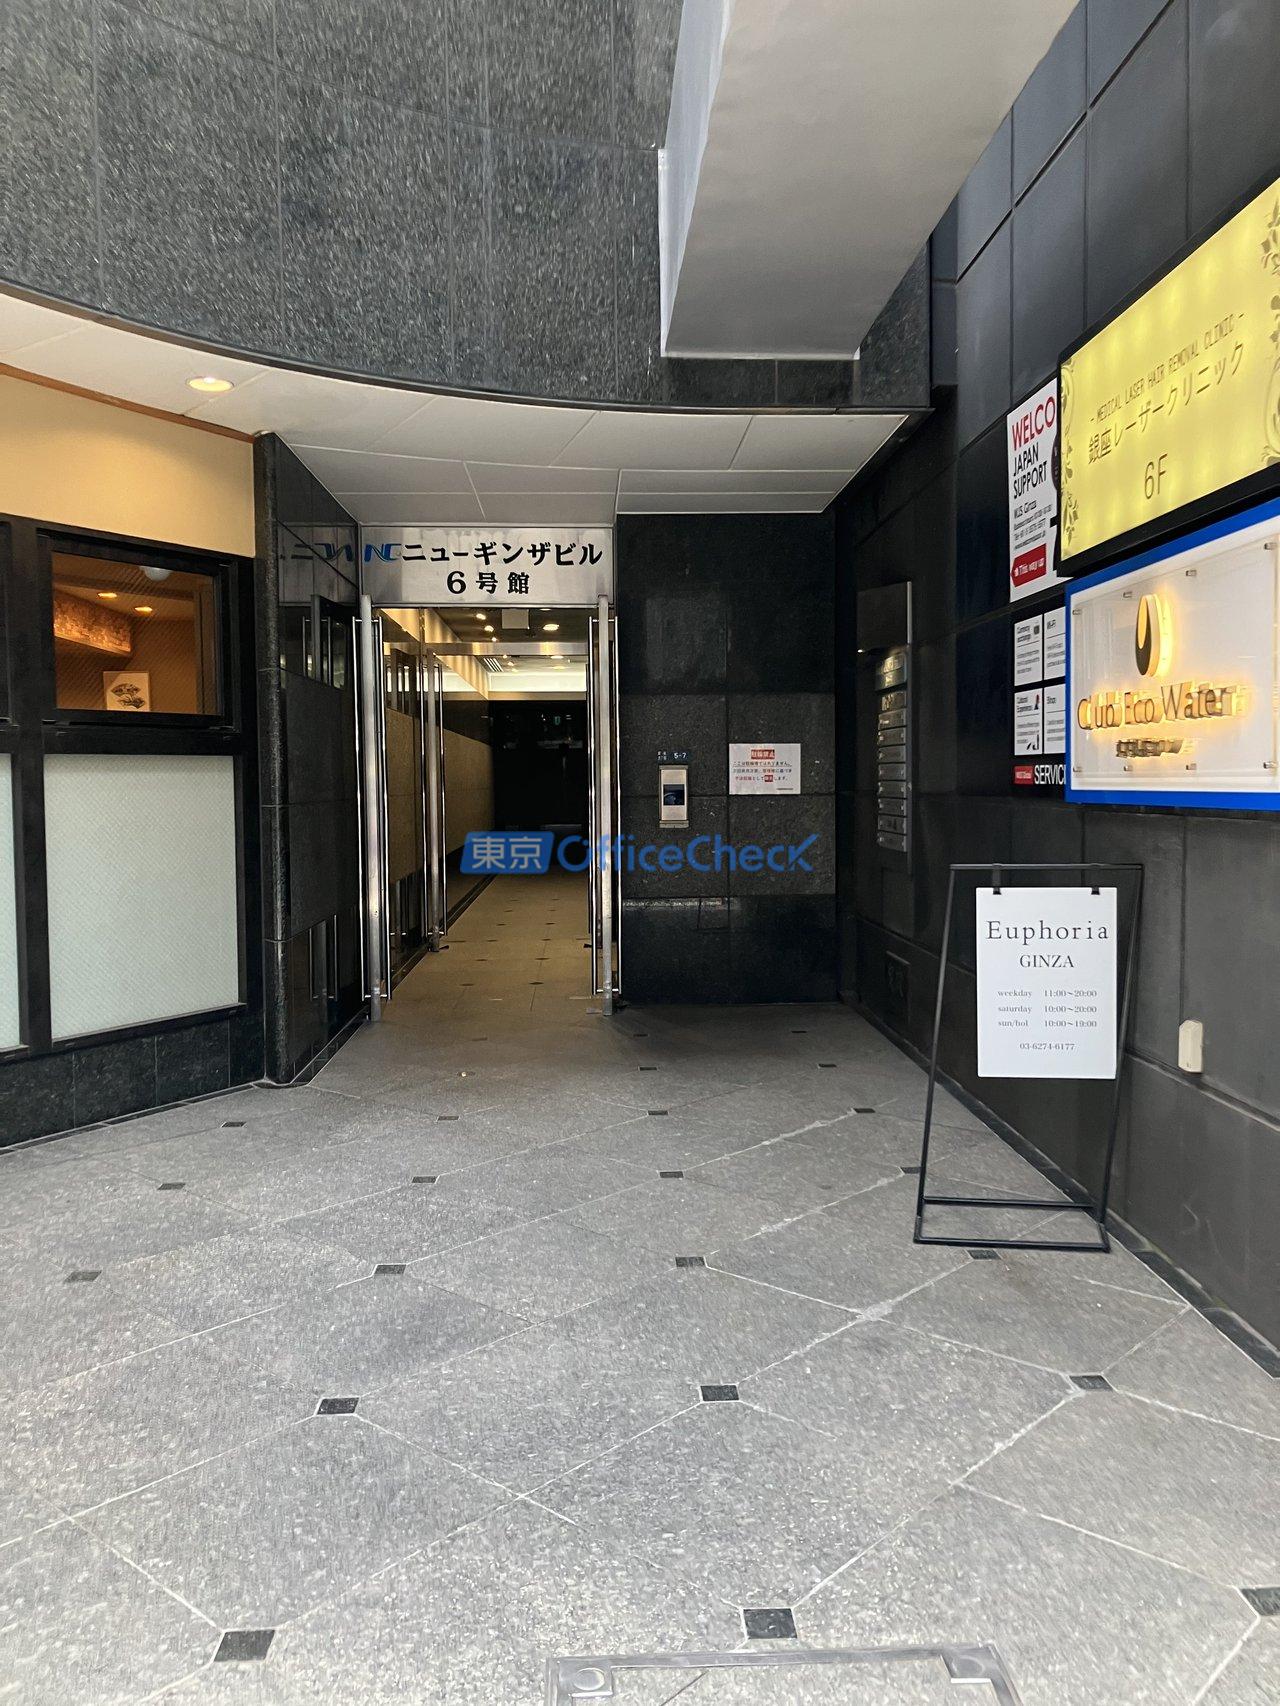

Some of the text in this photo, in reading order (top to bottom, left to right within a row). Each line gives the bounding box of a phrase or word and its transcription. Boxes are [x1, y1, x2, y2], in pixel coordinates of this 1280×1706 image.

[1097, 313, 1234, 423] MEDICAL LASER HAIR REMOVAL CLINIC
[1088, 340, 1244, 464] 銀座レーザークリニック
[1013, 442, 1039, 477] JAPAN
[1013, 460, 1048, 500] SUPPORT
[1144, 453, 1168, 500] 6F
[402, 541, 603, 566] ニューギンザビル
[1077, 692, 1119, 730] Club
[1124, 691, 1157, 725] Eco
[1160, 683, 1234, 721] Water
[1034, 764, 1066, 785] SERVIC
[986, 920, 1109, 946] Euphoria
[1019, 954, 1075, 969] GINZA
[997, 989, 1032, 999] weekday
[998, 1005, 1032, 1014] saturday
[998, 1019, 1029, 1028] sun/hol
[1019, 1042, 1075, 1051] 03-6274-6177
